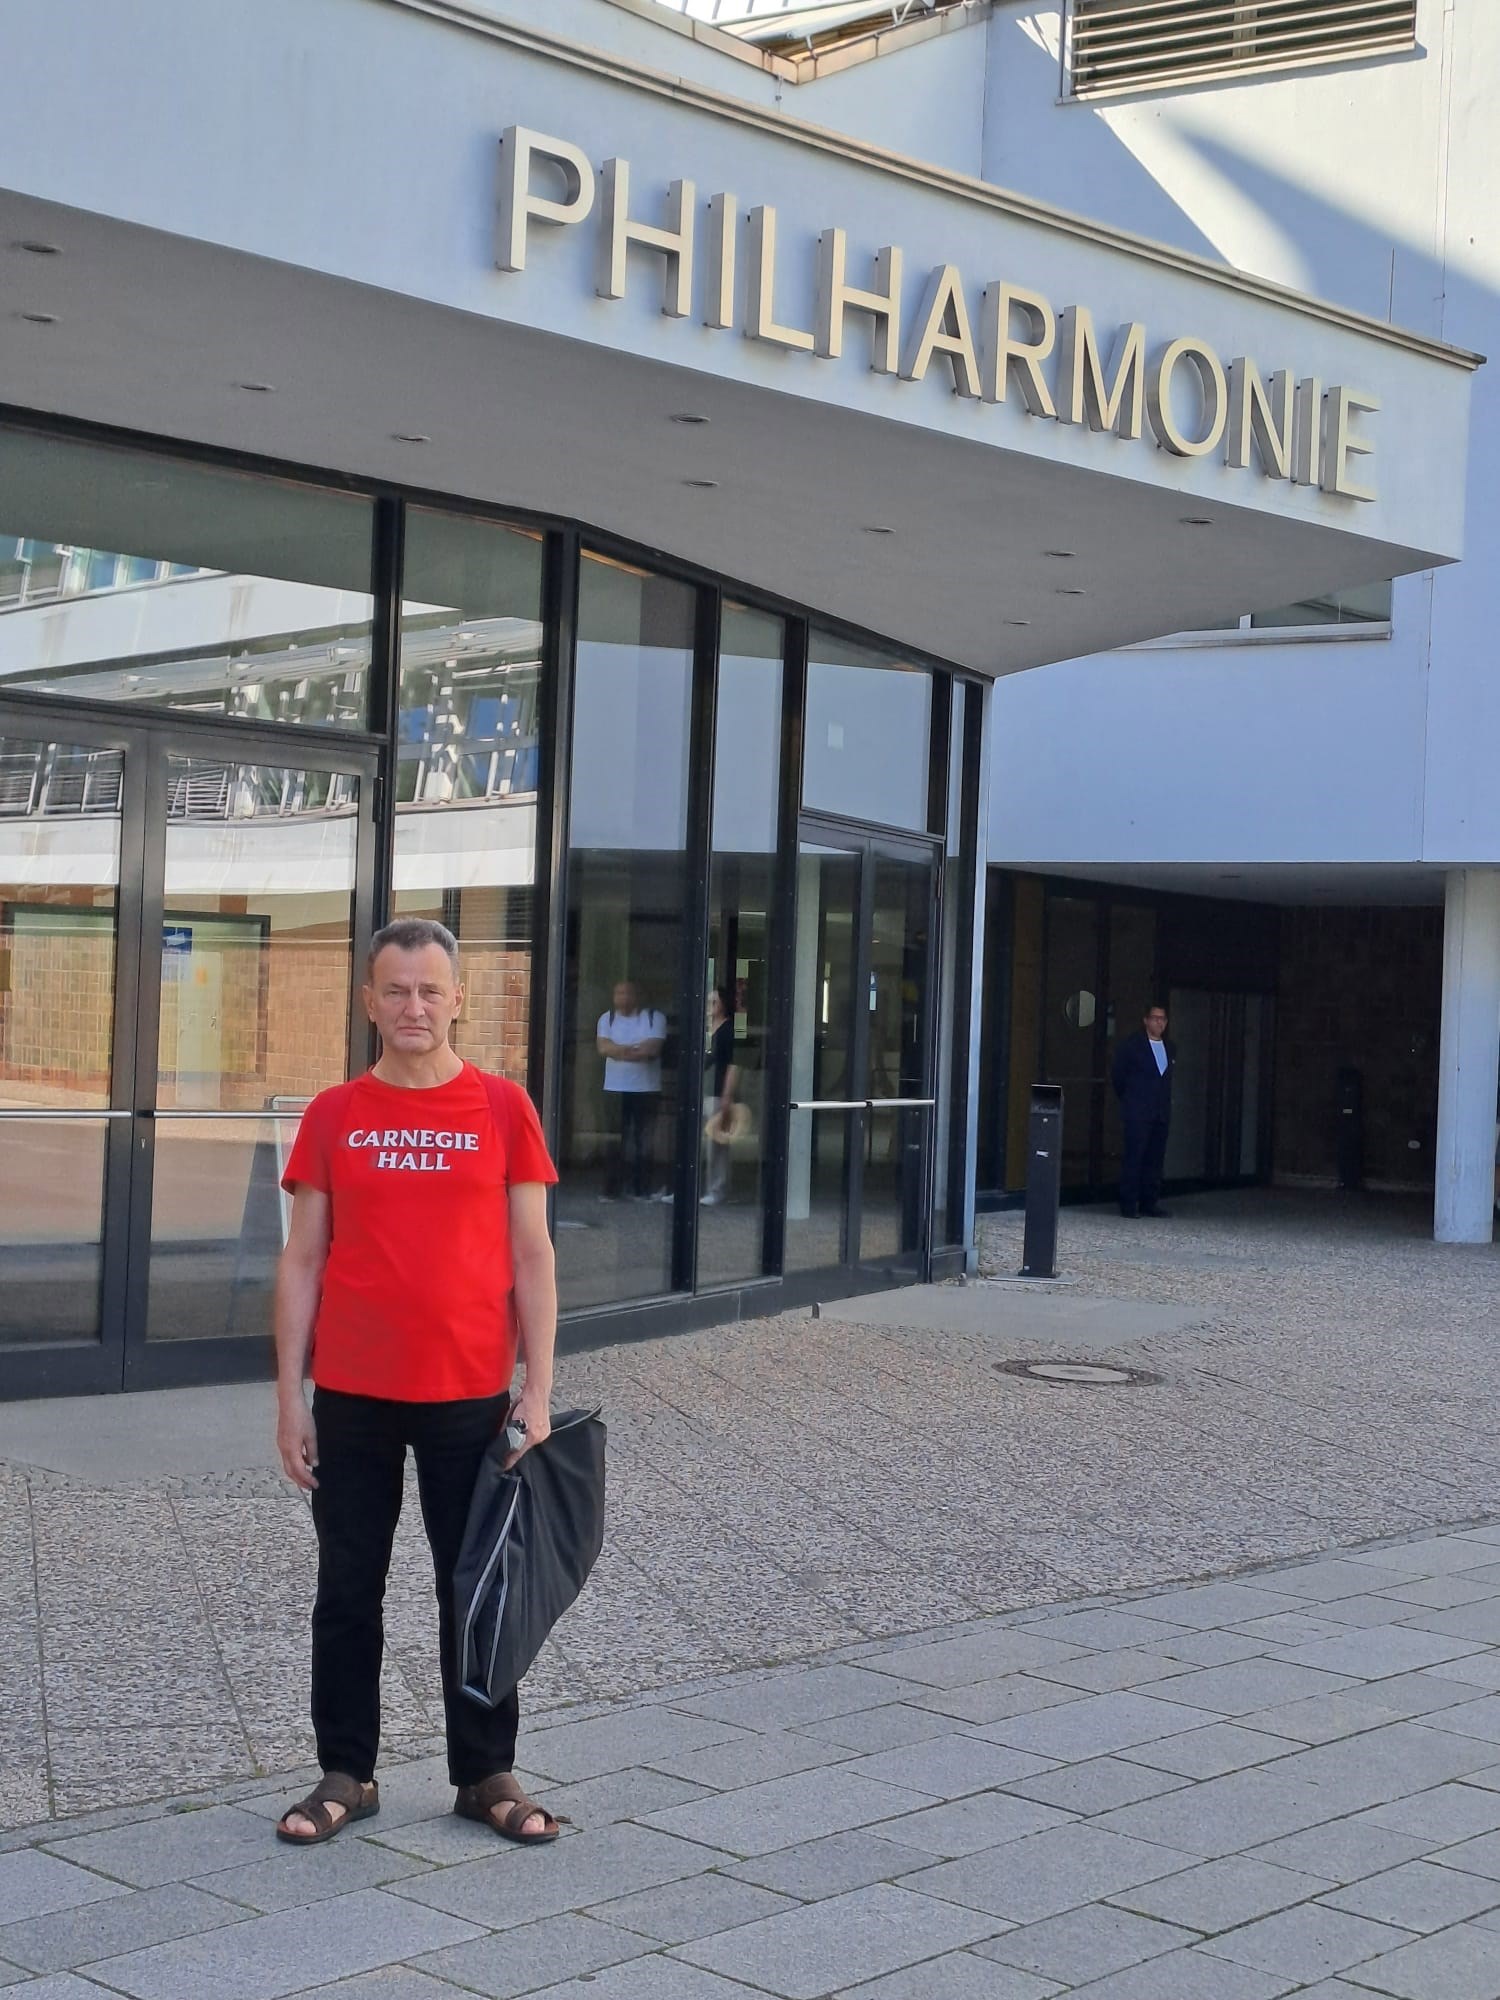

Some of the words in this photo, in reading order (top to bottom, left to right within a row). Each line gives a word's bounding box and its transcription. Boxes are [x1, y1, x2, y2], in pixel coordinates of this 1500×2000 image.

[498, 125, 1381, 502] PHILHARMONIE
[348, 1129, 479, 1151] CARNEGIE
[377, 1151, 451, 1171] HALL
